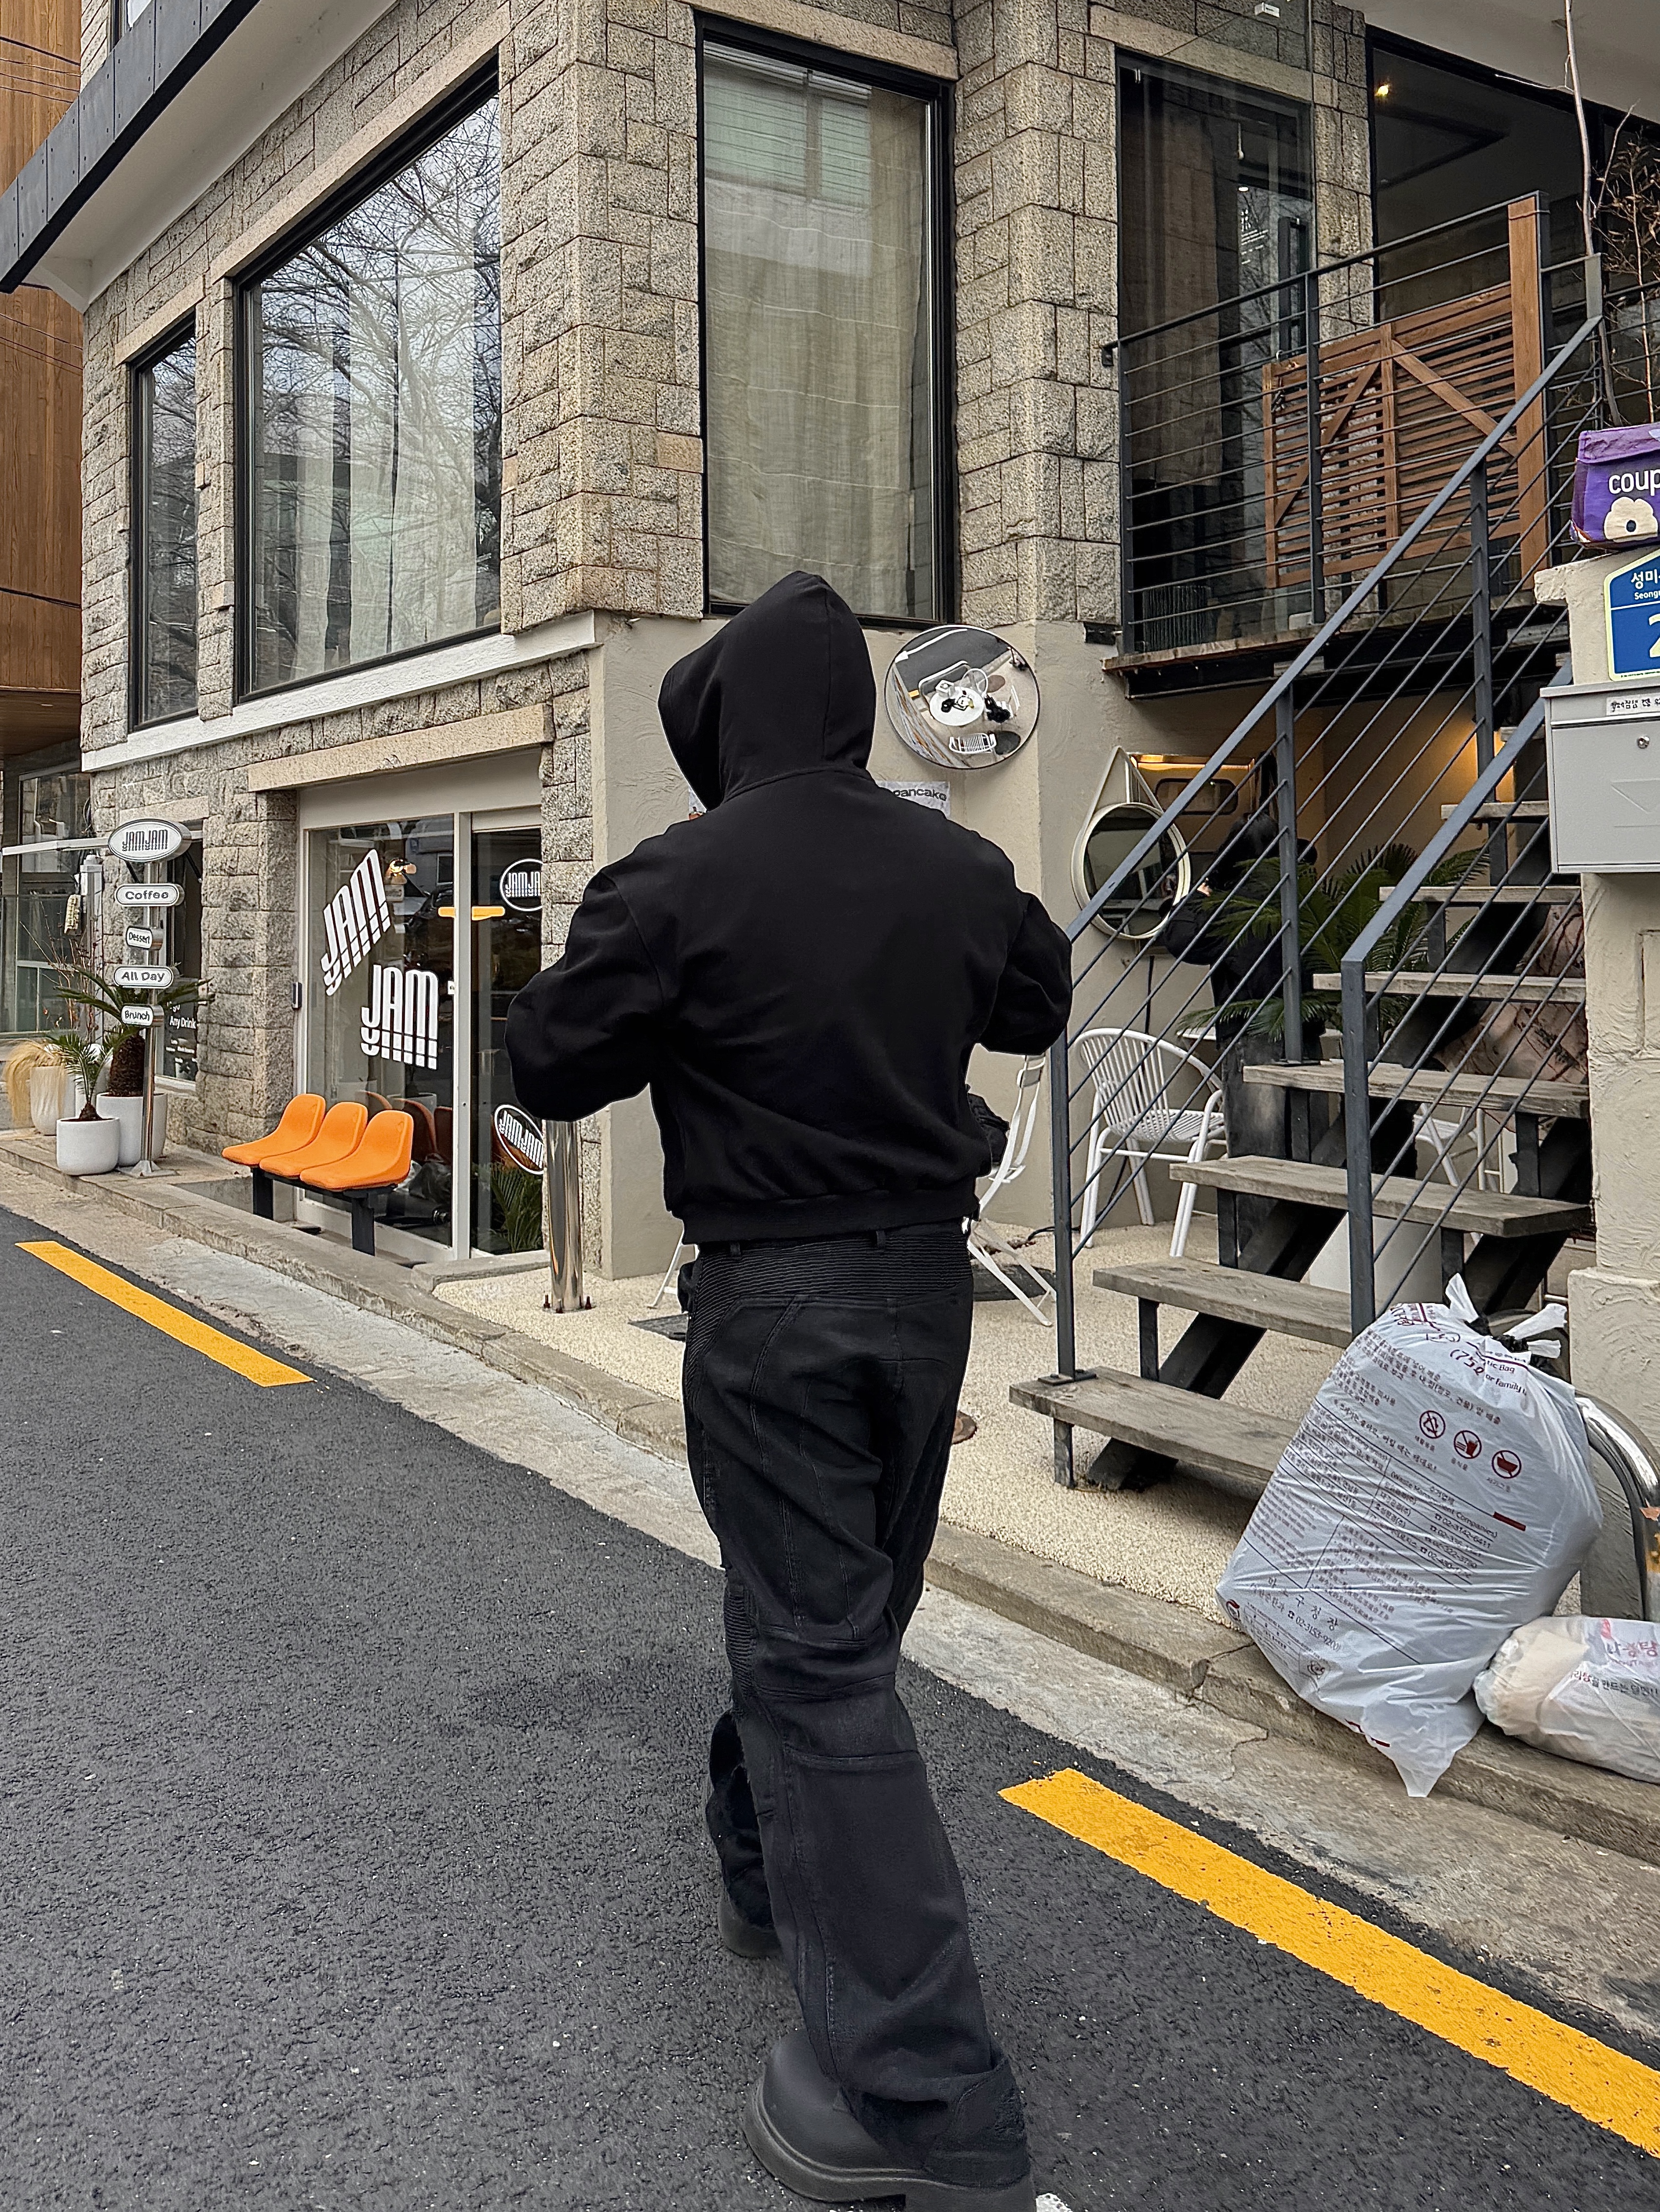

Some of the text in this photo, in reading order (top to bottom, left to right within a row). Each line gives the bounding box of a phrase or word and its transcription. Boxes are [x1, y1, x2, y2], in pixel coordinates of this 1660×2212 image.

[1631, 569, 1660, 589] 성미
[1634, 590, 1660, 600] Seong
[505, 871, 541, 897] JAMJA
[125, 890, 169, 900] Coffee
[128, 932, 150, 944] Dessert
[121, 972, 165, 982] All Day
[125, 1010, 150, 1021] Brunch
[170, 1016, 196, 1029] Any Drink
[1499, 1363, 1516, 1374] Bag
[1495, 1378, 1522, 1393] family
[1570, 1671, 1599, 1688] 리탕을
